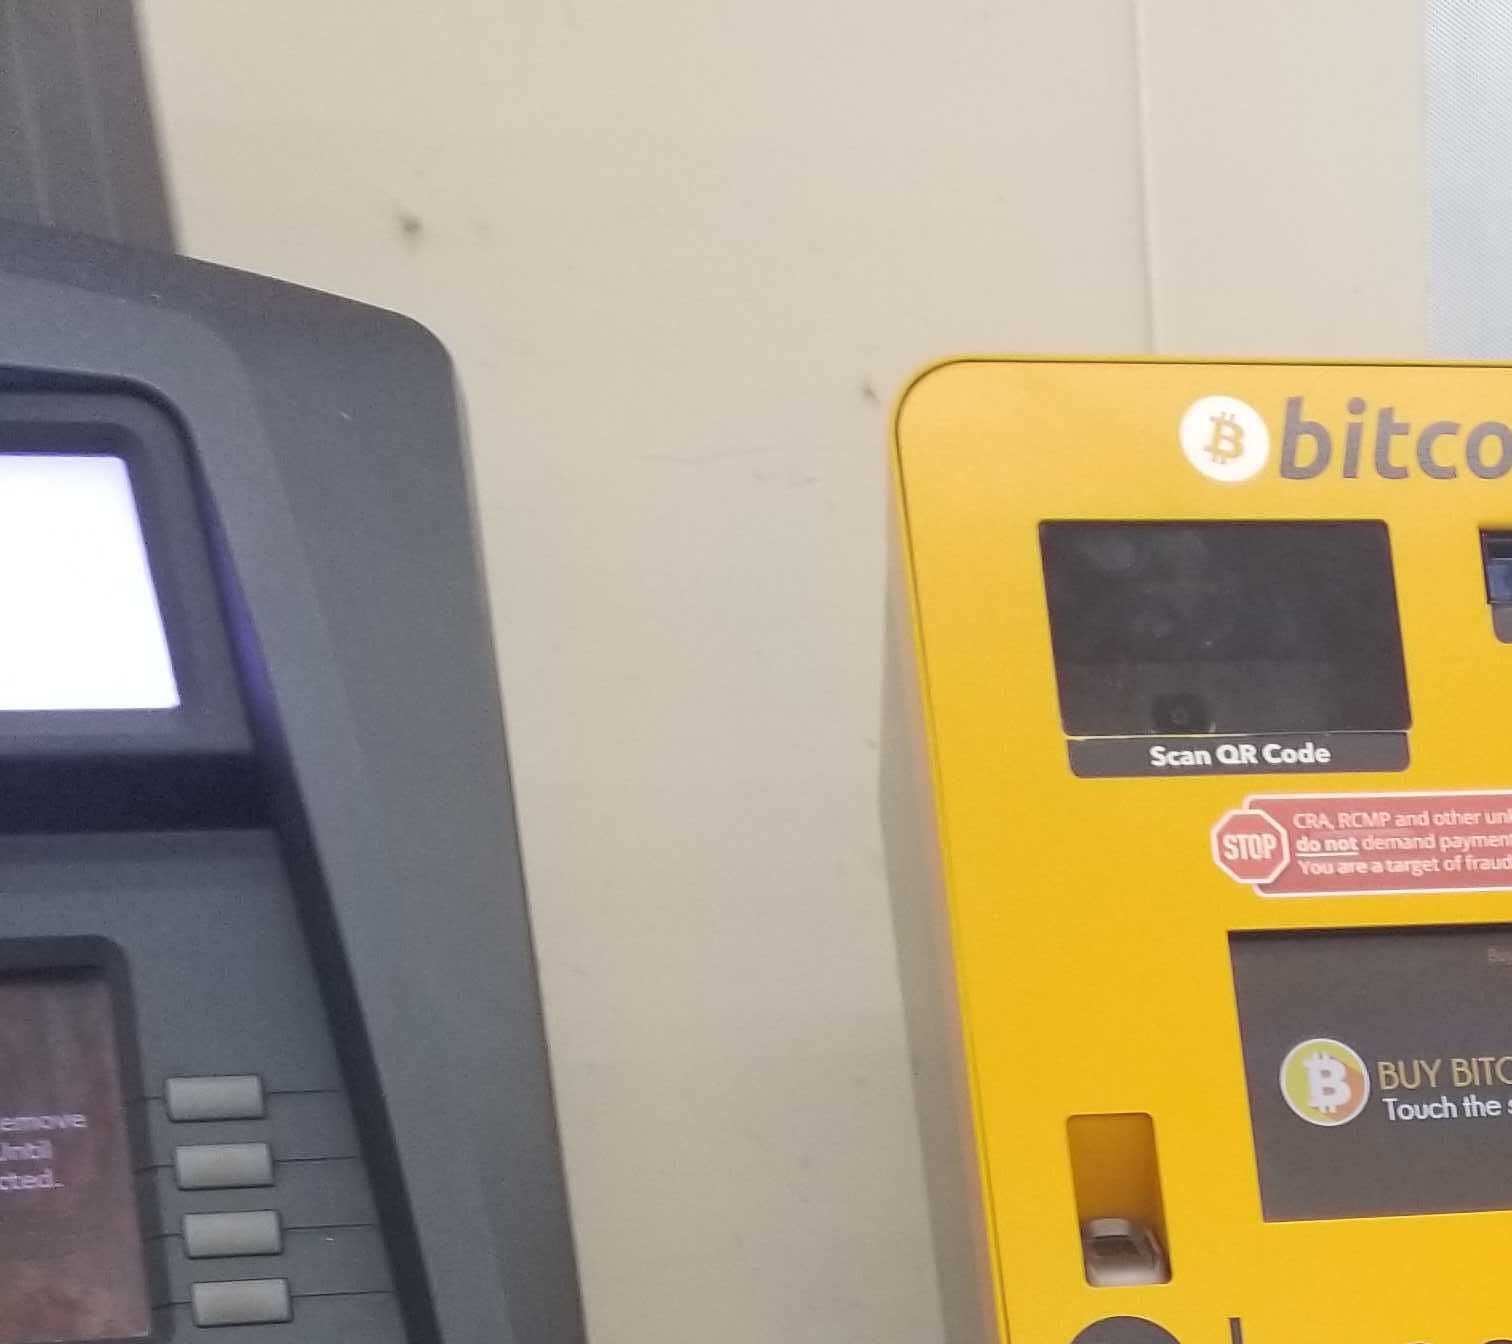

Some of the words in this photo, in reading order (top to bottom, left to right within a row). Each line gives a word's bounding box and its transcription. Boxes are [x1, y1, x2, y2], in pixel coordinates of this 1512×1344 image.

[1149, 745, 1211, 767] Scan
[1215, 744, 1258, 765] QR
[1262, 742, 1331, 763] Code
[1293, 812, 1334, 831] CRA,
[1338, 811, 1391, 829] RCMP
[1394, 810, 1430, 827] and
[1432, 809, 1481, 826] other
[1222, 833, 1277, 861] STOP
[1295, 835, 1321, 852] do
[1325, 835, 1359, 852] not
[1361, 833, 1435, 851] demand
[1299, 859, 1335, 877] You
[1336, 860, 1370, 875] are
[1372, 860, 1384, 874] a
[1385, 856, 1440, 877] target
[1442, 854, 1463, 872] of
[1376, 1057, 1442, 1091] BUY
[1382, 1095, 1458, 1122] Touch
[1461, 1093, 1502, 1118] the
